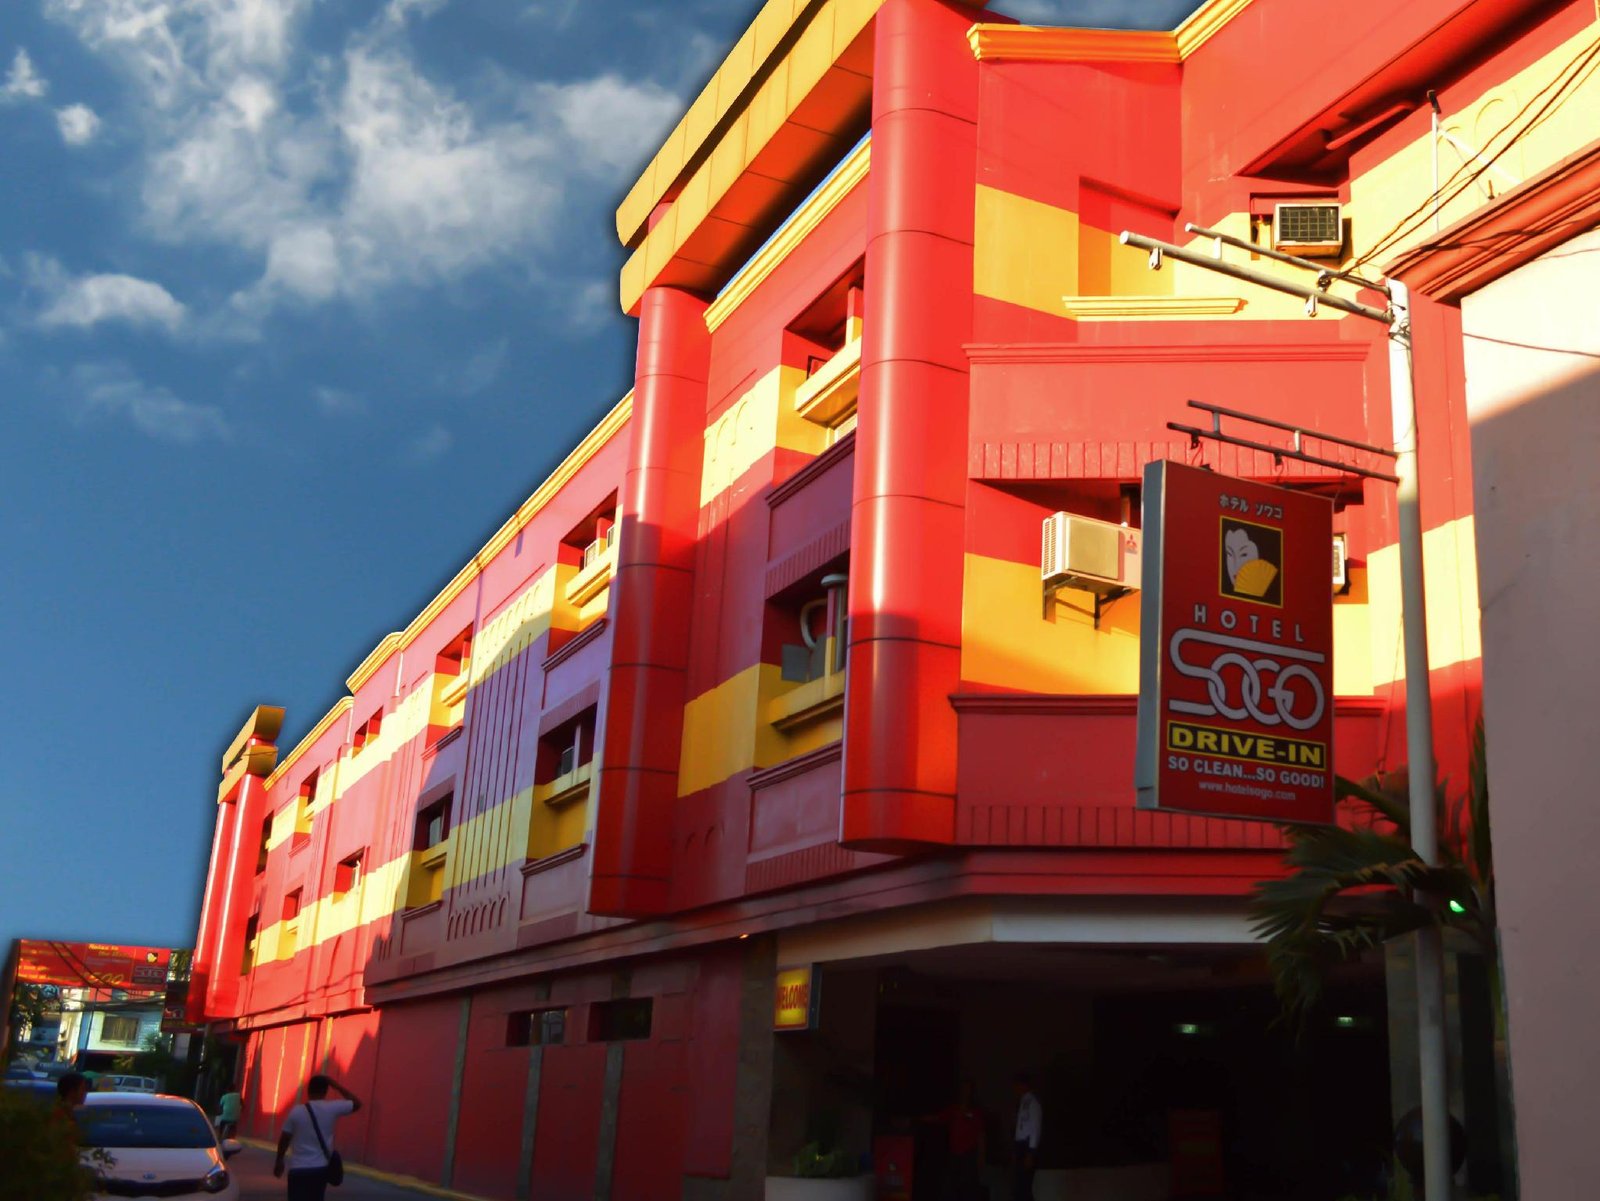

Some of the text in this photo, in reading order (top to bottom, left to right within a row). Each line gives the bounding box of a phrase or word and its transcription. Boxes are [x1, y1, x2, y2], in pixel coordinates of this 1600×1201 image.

[1219, 493, 1248, 512] ホテル
[1194, 604, 1304, 642] HOTEL
[1168, 627, 1325, 731] SOGO
[1171, 726, 1322, 765] DRIVE-IN
[1168, 755, 1189, 771] SO
[1280, 771, 1324, 788] GOOD!
[1198, 781, 1296, 800] www.hotelsogo.com
